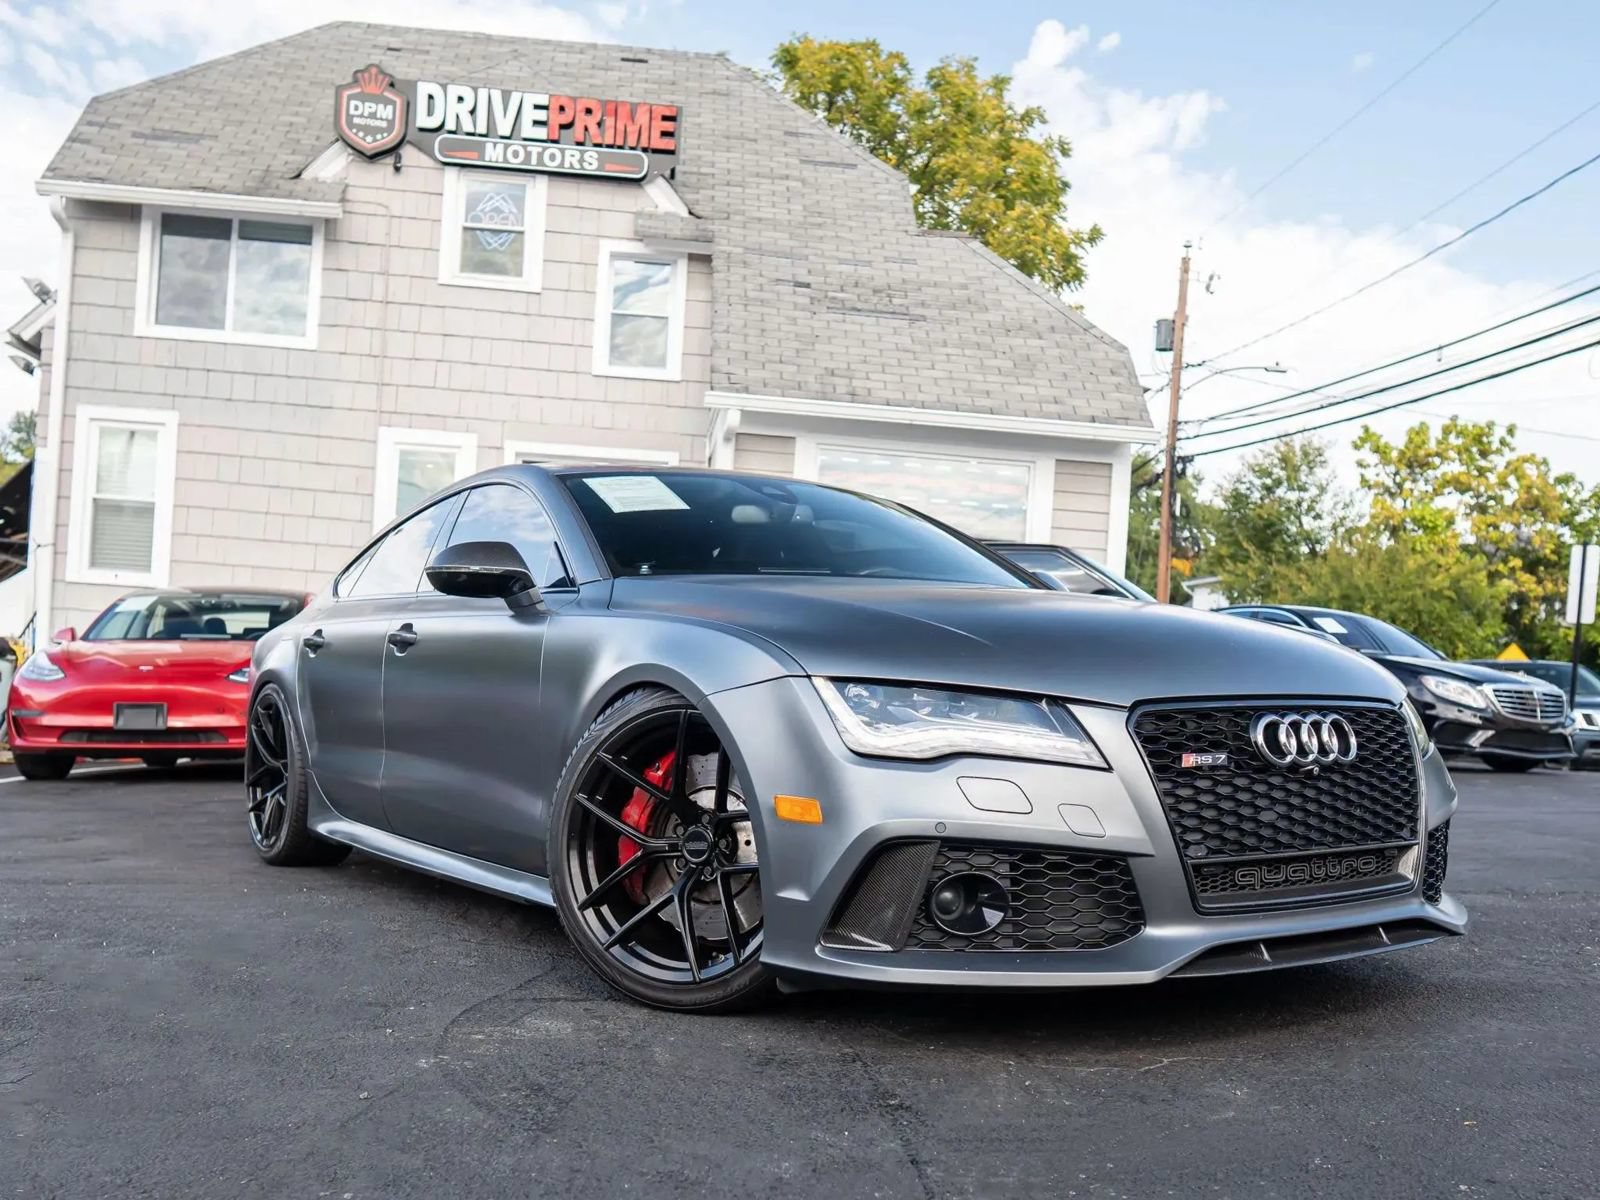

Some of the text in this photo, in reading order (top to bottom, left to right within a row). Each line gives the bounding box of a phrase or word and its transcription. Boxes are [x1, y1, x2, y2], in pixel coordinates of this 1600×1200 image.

[349, 100, 393, 120] DPM
[484, 142, 599, 170] MOTORS
[1235, 856, 1376, 889] quattro
